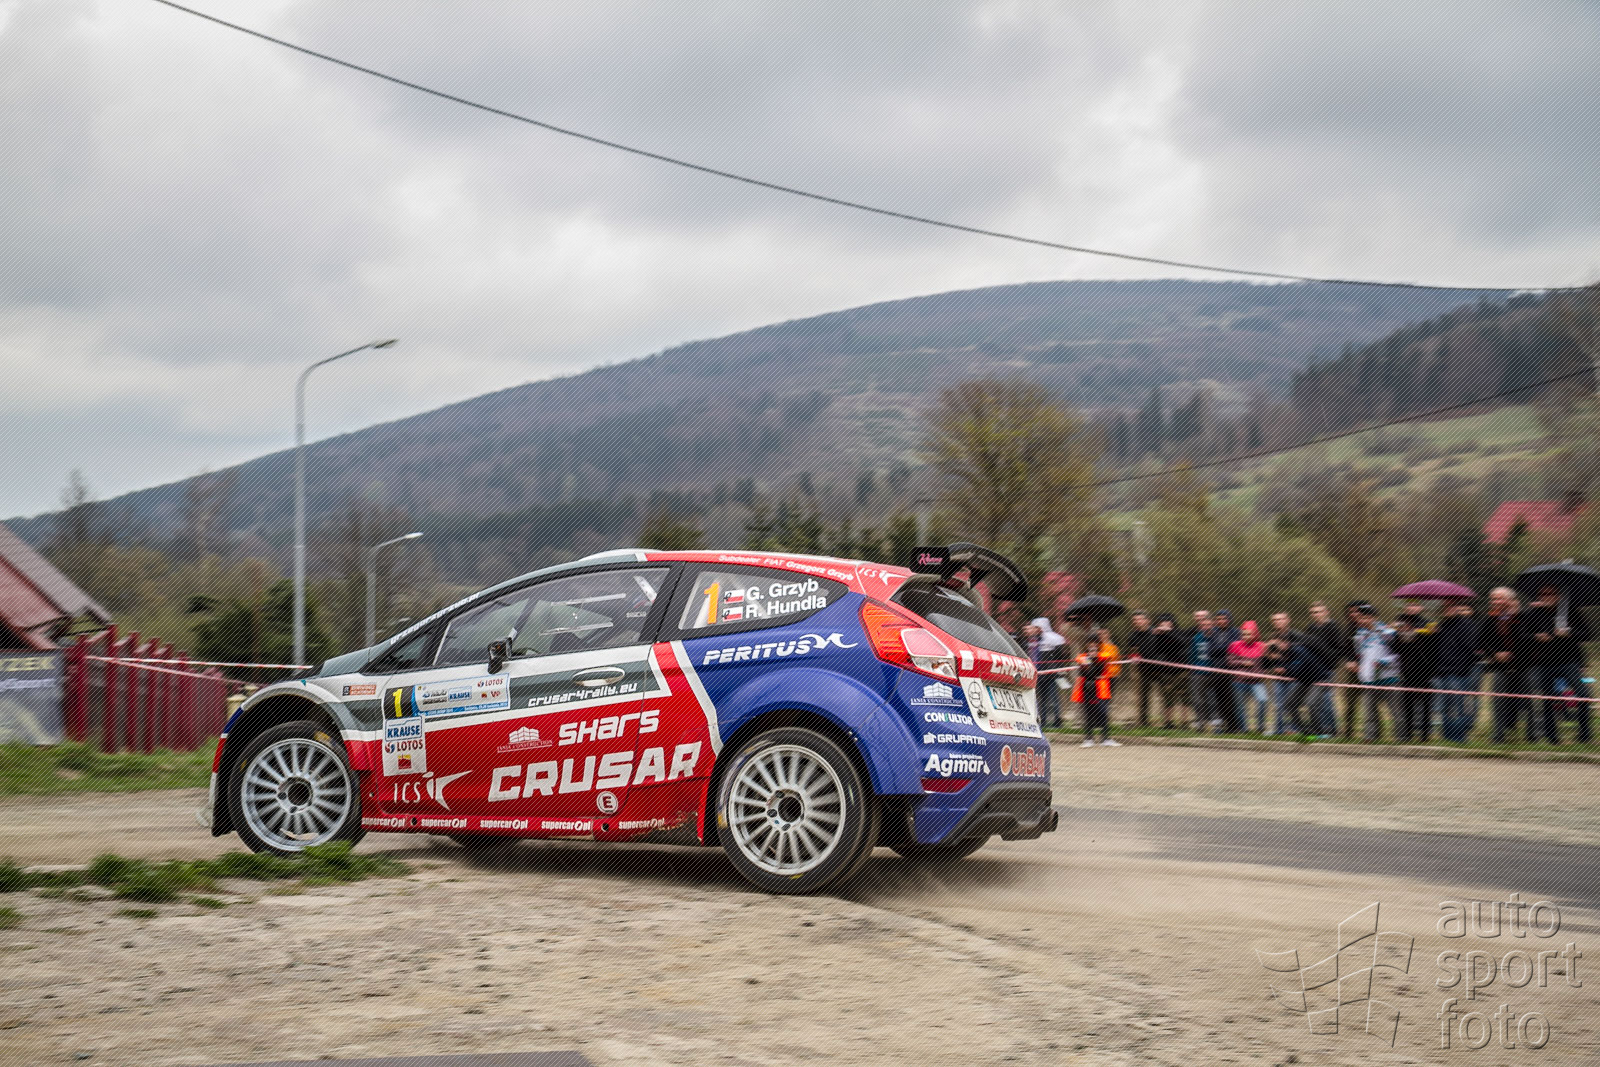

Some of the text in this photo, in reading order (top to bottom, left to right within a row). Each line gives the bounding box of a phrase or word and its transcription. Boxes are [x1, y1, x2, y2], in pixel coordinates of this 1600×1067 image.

[763, 558, 785, 566] FIAT
[786, 561, 825, 574] Grzegorz
[827, 568, 854, 581] Grzyb
[859, 567, 877, 578] ICS
[746, 578, 819, 601] G. Grzyb
[704, 582, 720, 625] 1
[745, 595, 827, 619] R. Hundla
[702, 640, 812, 666] PERITUS
[392, 688, 403, 718] 1
[387, 725, 420, 738] KRAUSE
[397, 739, 424, 752] LOTOS
[488, 740, 702, 803] CRUSAR
[924, 753, 984, 777] Agmar
[1012, 746, 1046, 777] URBAN
[393, 781, 421, 804] ICS
